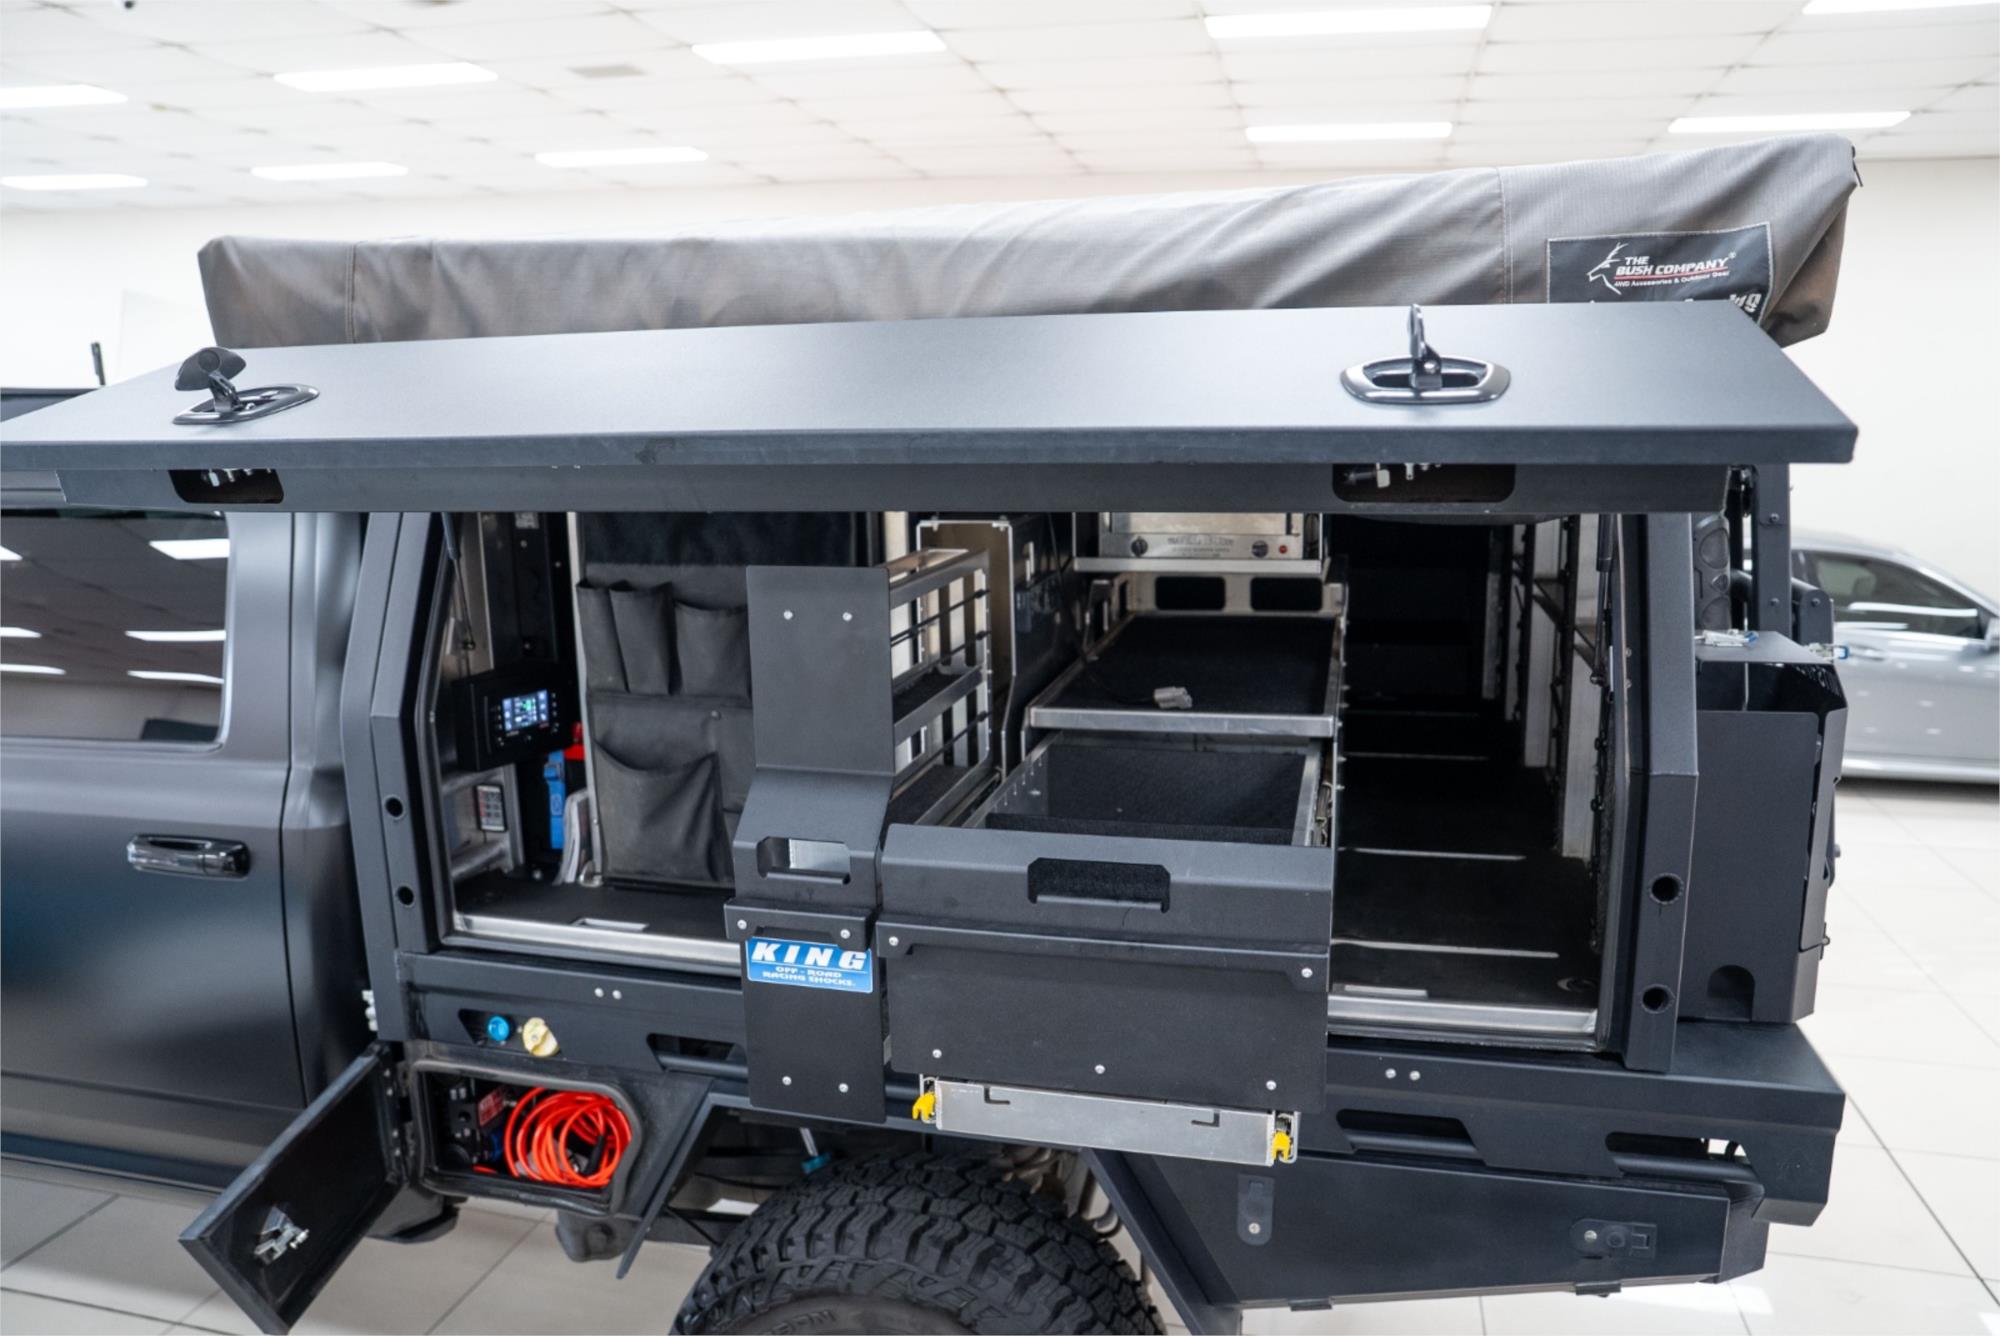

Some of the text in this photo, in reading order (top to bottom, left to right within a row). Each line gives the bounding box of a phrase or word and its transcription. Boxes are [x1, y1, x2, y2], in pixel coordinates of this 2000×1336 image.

[1615, 257, 1729, 276] BUSH COMPANY
[1625, 256, 1650, 266] THE
[751, 941, 867, 970] KING
